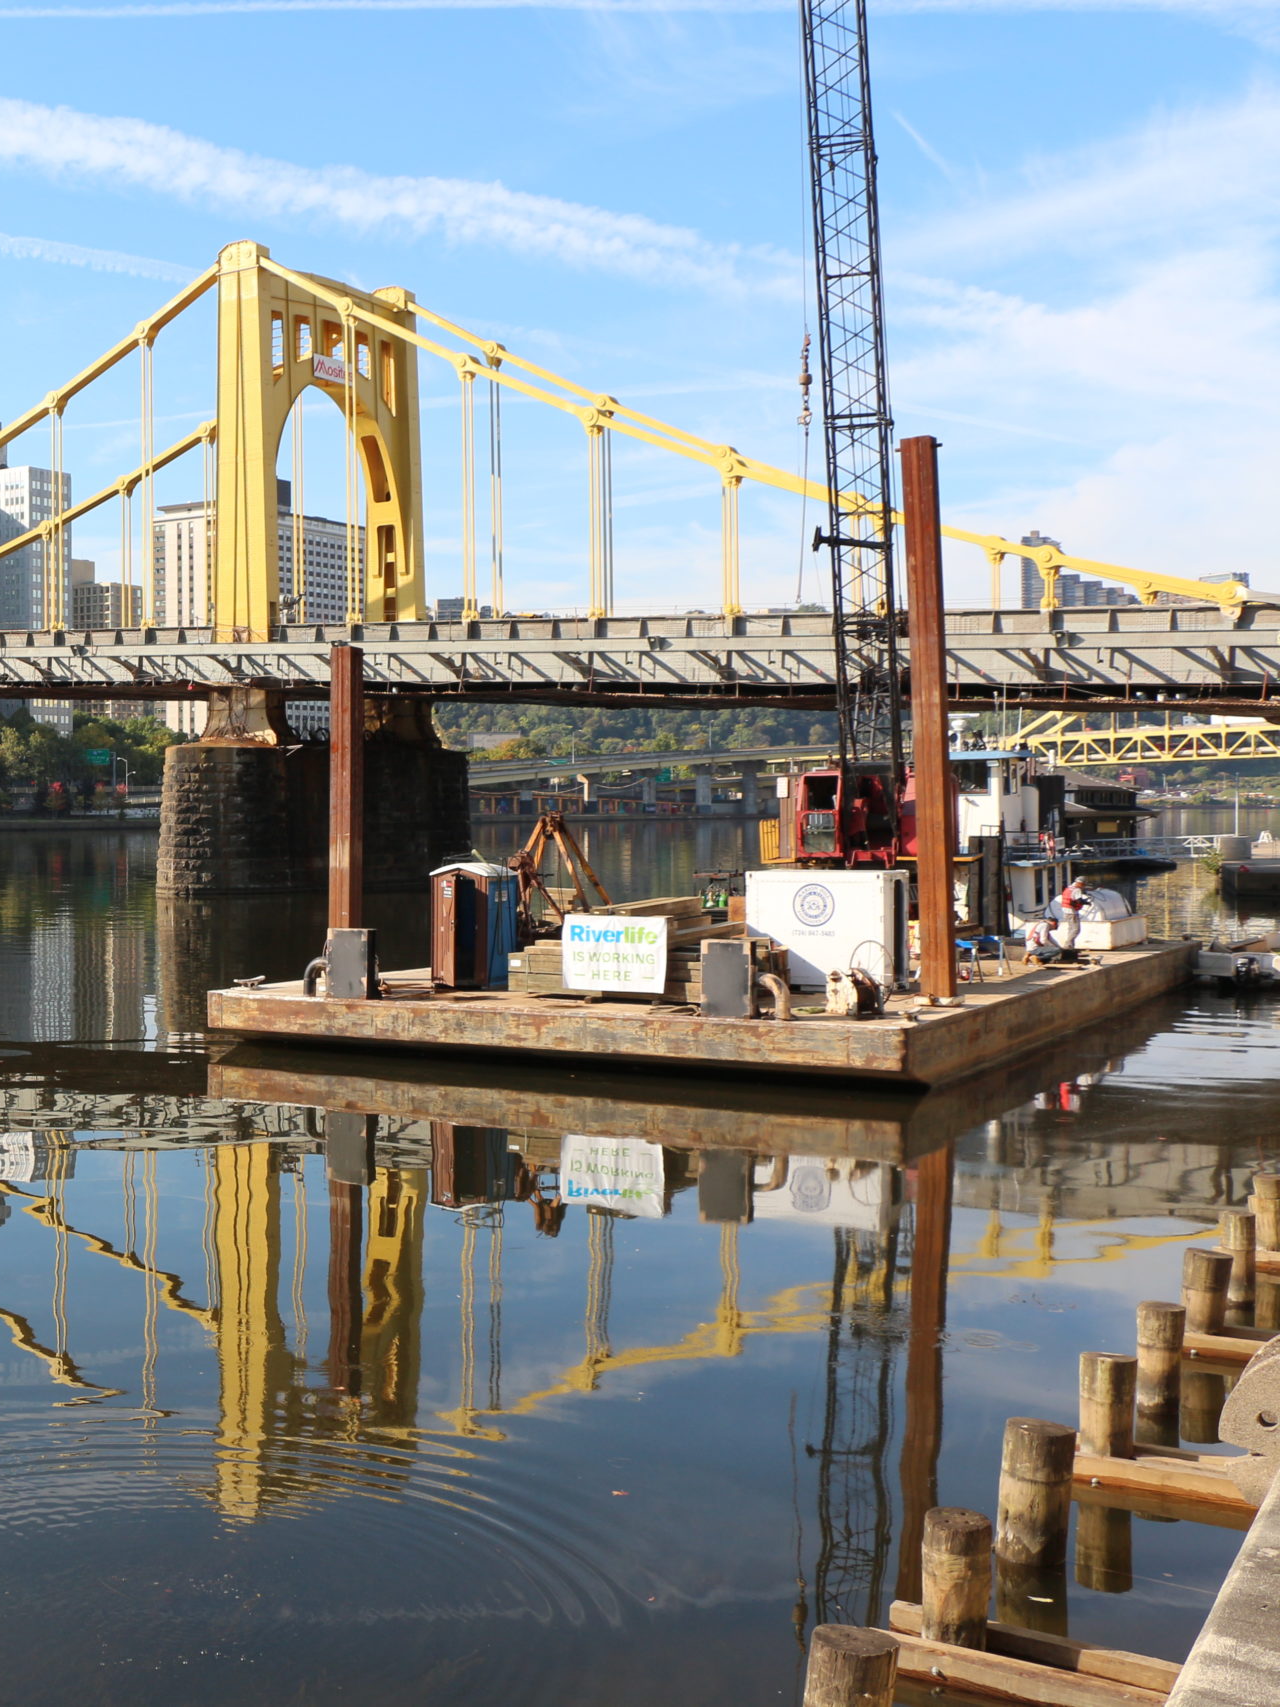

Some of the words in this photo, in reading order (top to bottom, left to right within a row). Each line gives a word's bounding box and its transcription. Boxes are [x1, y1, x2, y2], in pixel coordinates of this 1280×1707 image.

[570, 924, 658, 945] Riverlife
[573, 951, 585, 962] IS
[588, 952, 656, 965] WORKING
[591, 969, 632, 982] HERE
